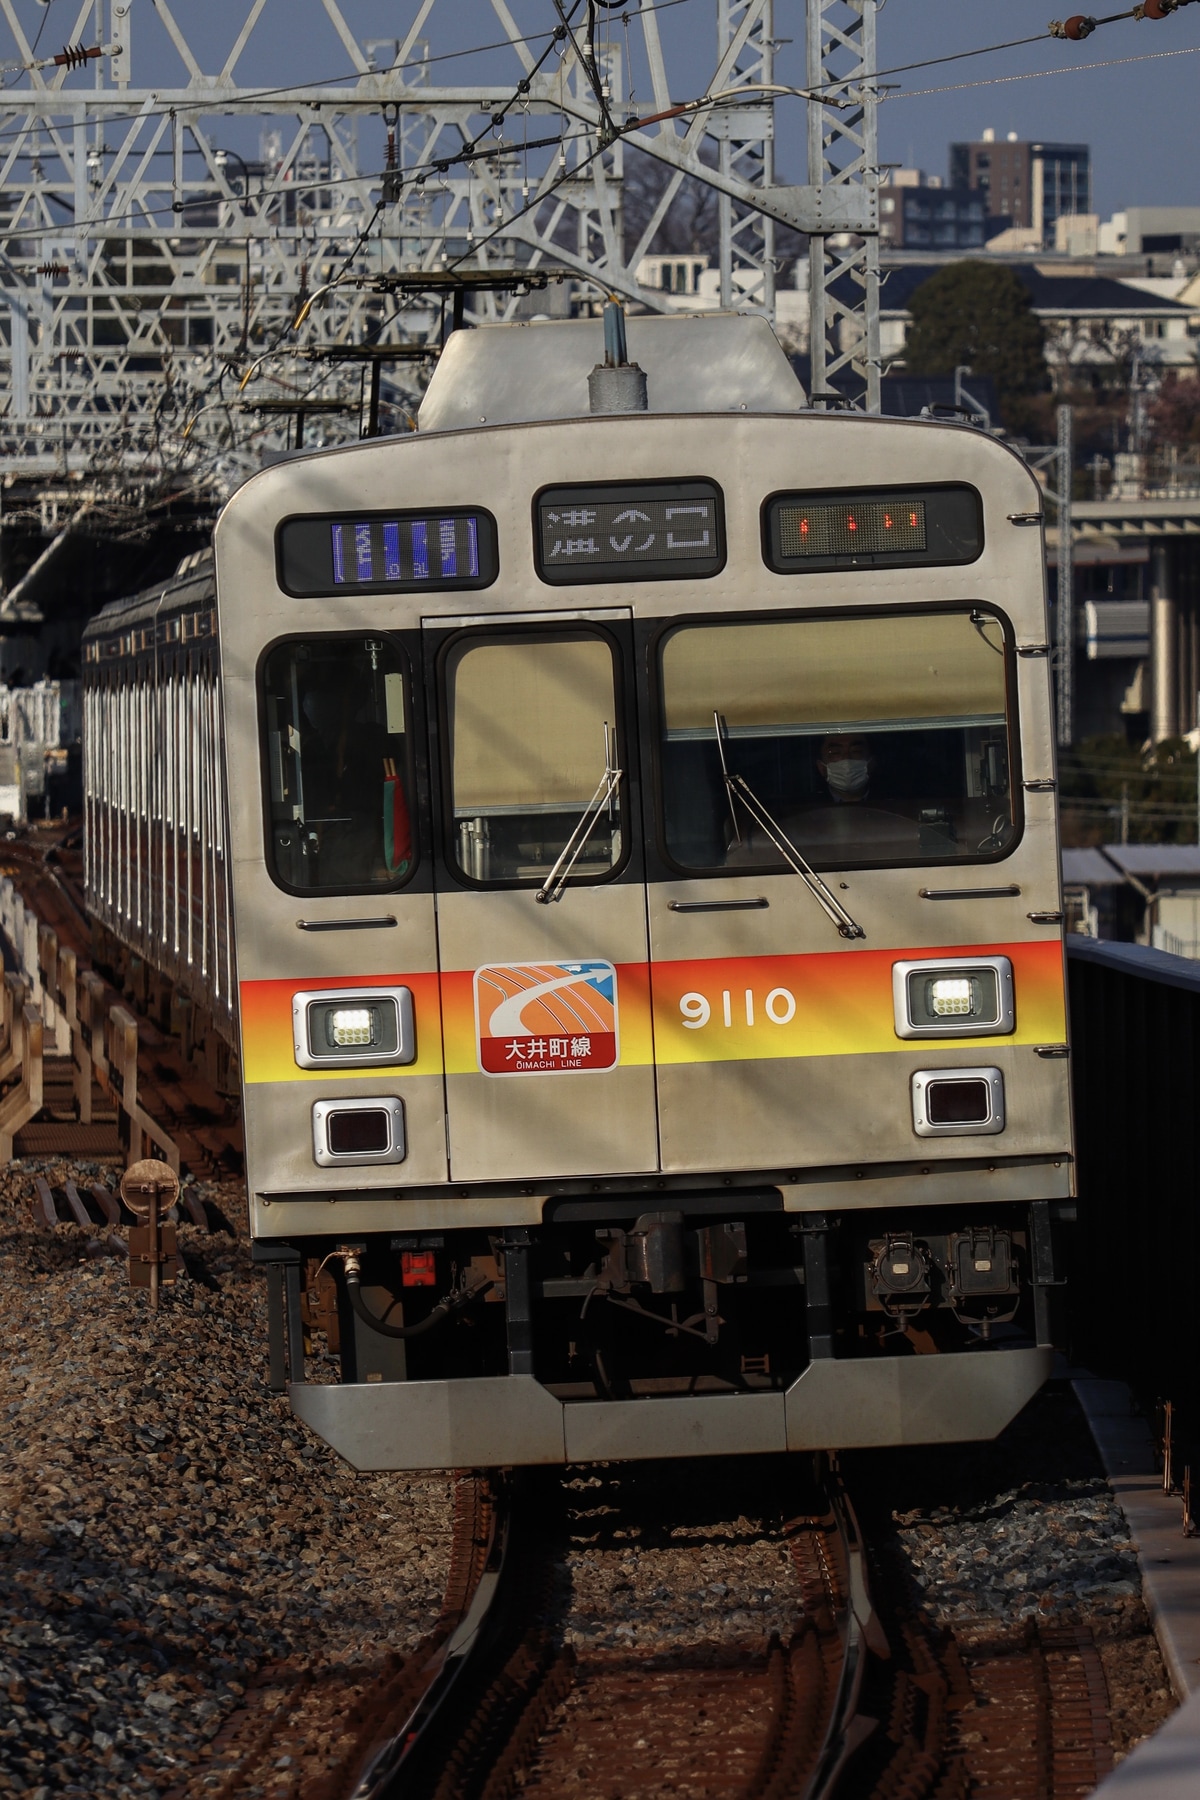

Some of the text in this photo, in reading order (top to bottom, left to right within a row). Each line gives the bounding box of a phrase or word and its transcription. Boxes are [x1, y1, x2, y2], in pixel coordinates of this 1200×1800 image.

[679, 987, 796, 1029] 9110
[505, 1036, 592, 1060] 大井町線
[561, 1059, 582, 1068] LINE
